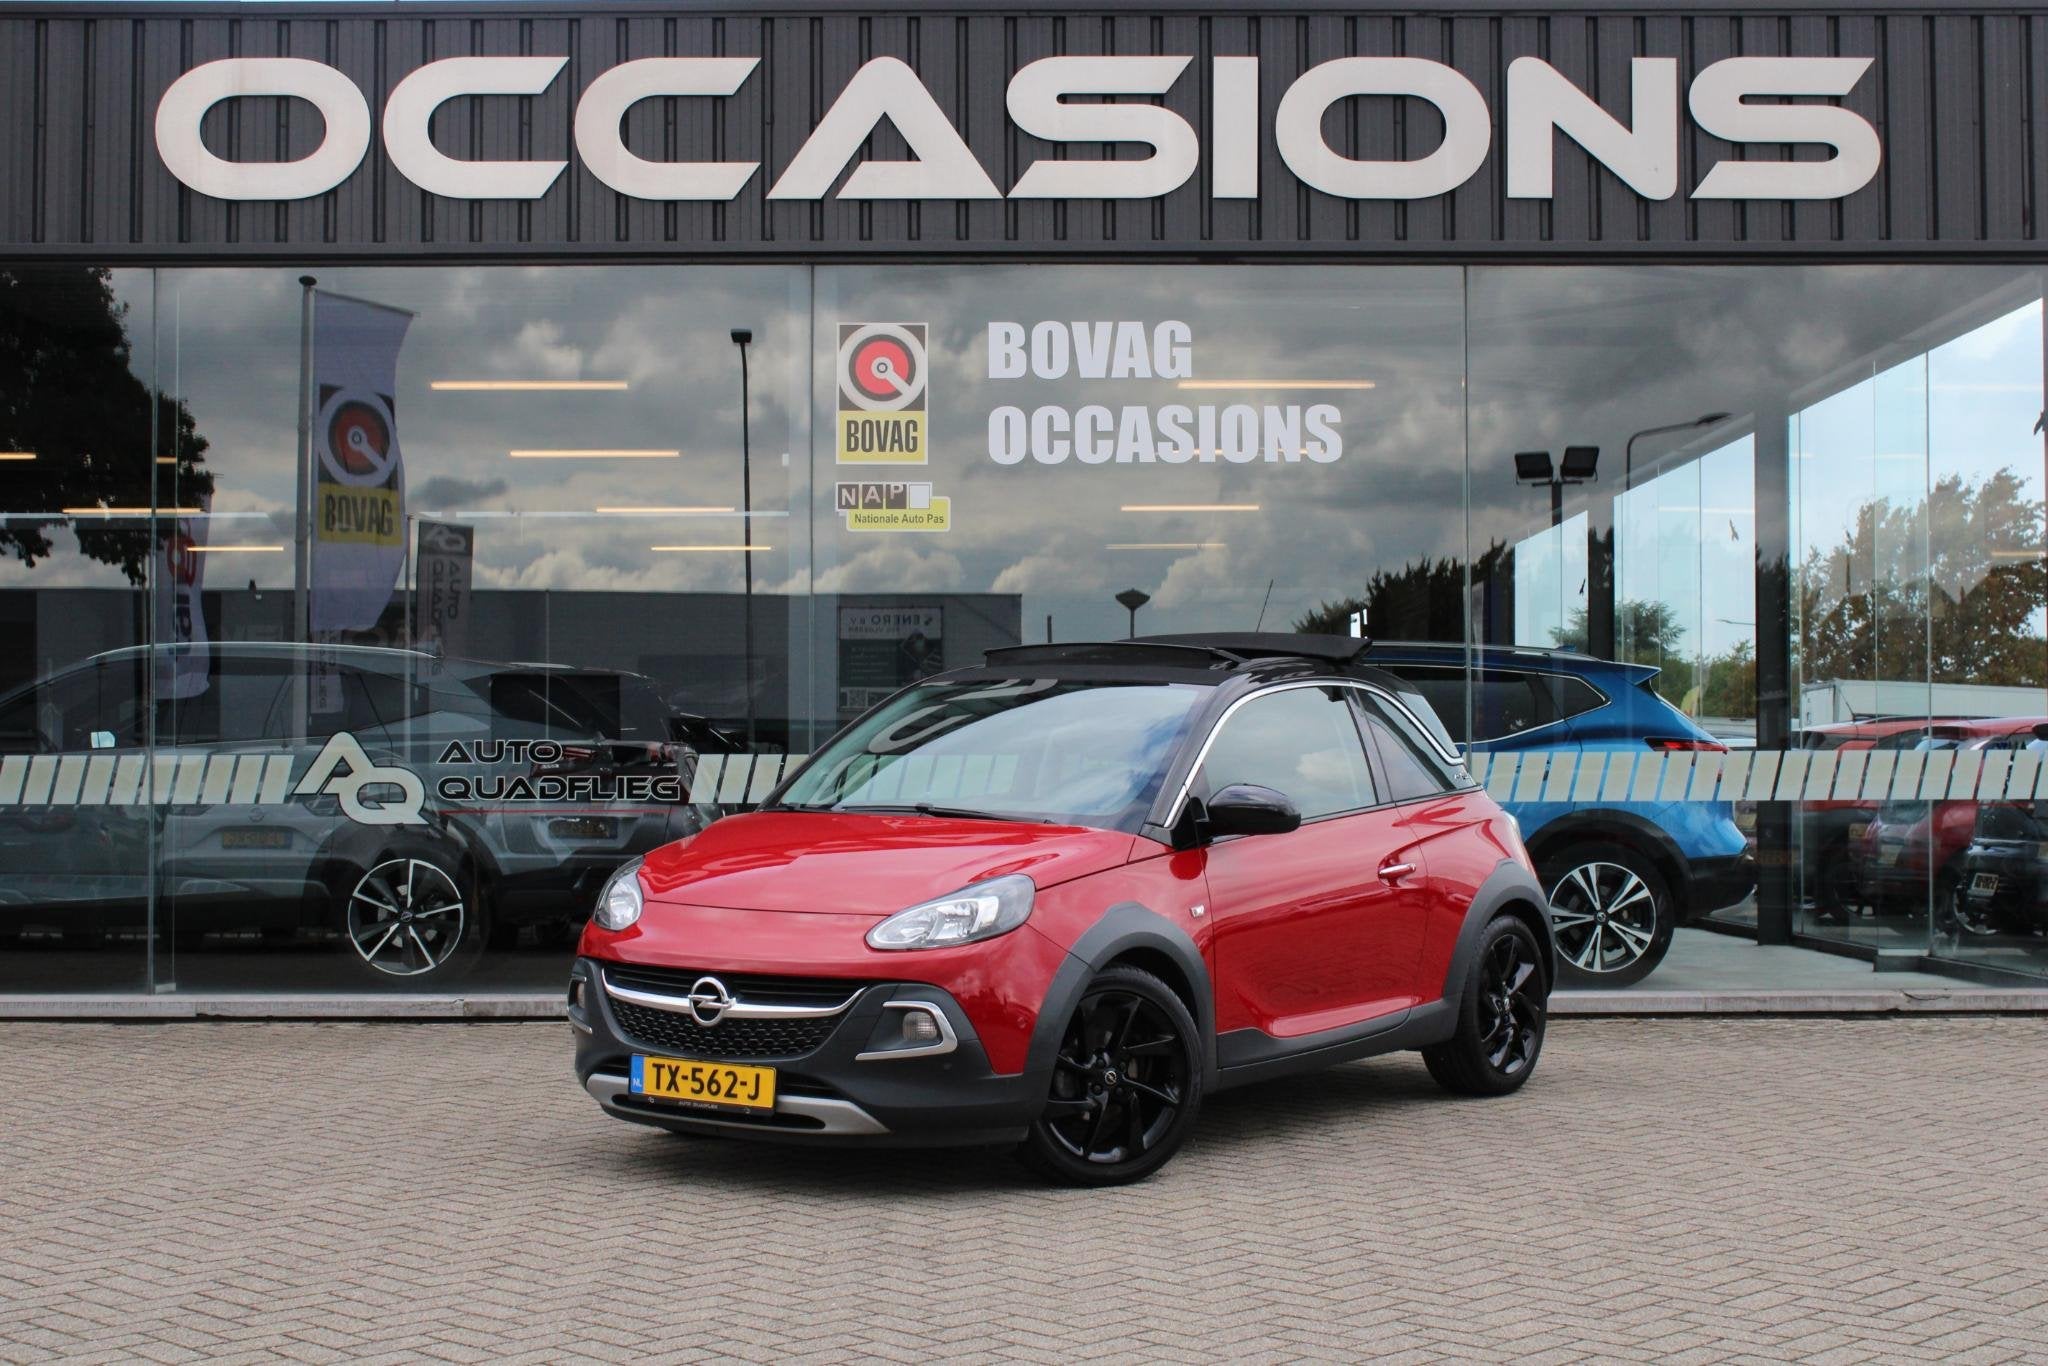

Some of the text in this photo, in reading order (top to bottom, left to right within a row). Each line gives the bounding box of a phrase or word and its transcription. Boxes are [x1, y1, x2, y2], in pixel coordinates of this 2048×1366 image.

[155, 55, 1881, 201] OCCASIONS
[988, 320, 1192, 379] BOVAG
[846, 420, 918, 453] BOVAG
[988, 403, 1342, 464] OCCASIONS
[841, 484, 904, 506] NAP
[325, 494, 393, 536] BOVAG
[854, 513, 945, 524] Nationale Auto Pas
[437, 739, 563, 764] AUTO
[293, 731, 429, 825] AQ
[437, 776, 680, 801] QUADFLIEG
[632, 1078, 642, 1088] NL
[652, 1063, 760, 1100] TX-562-J
